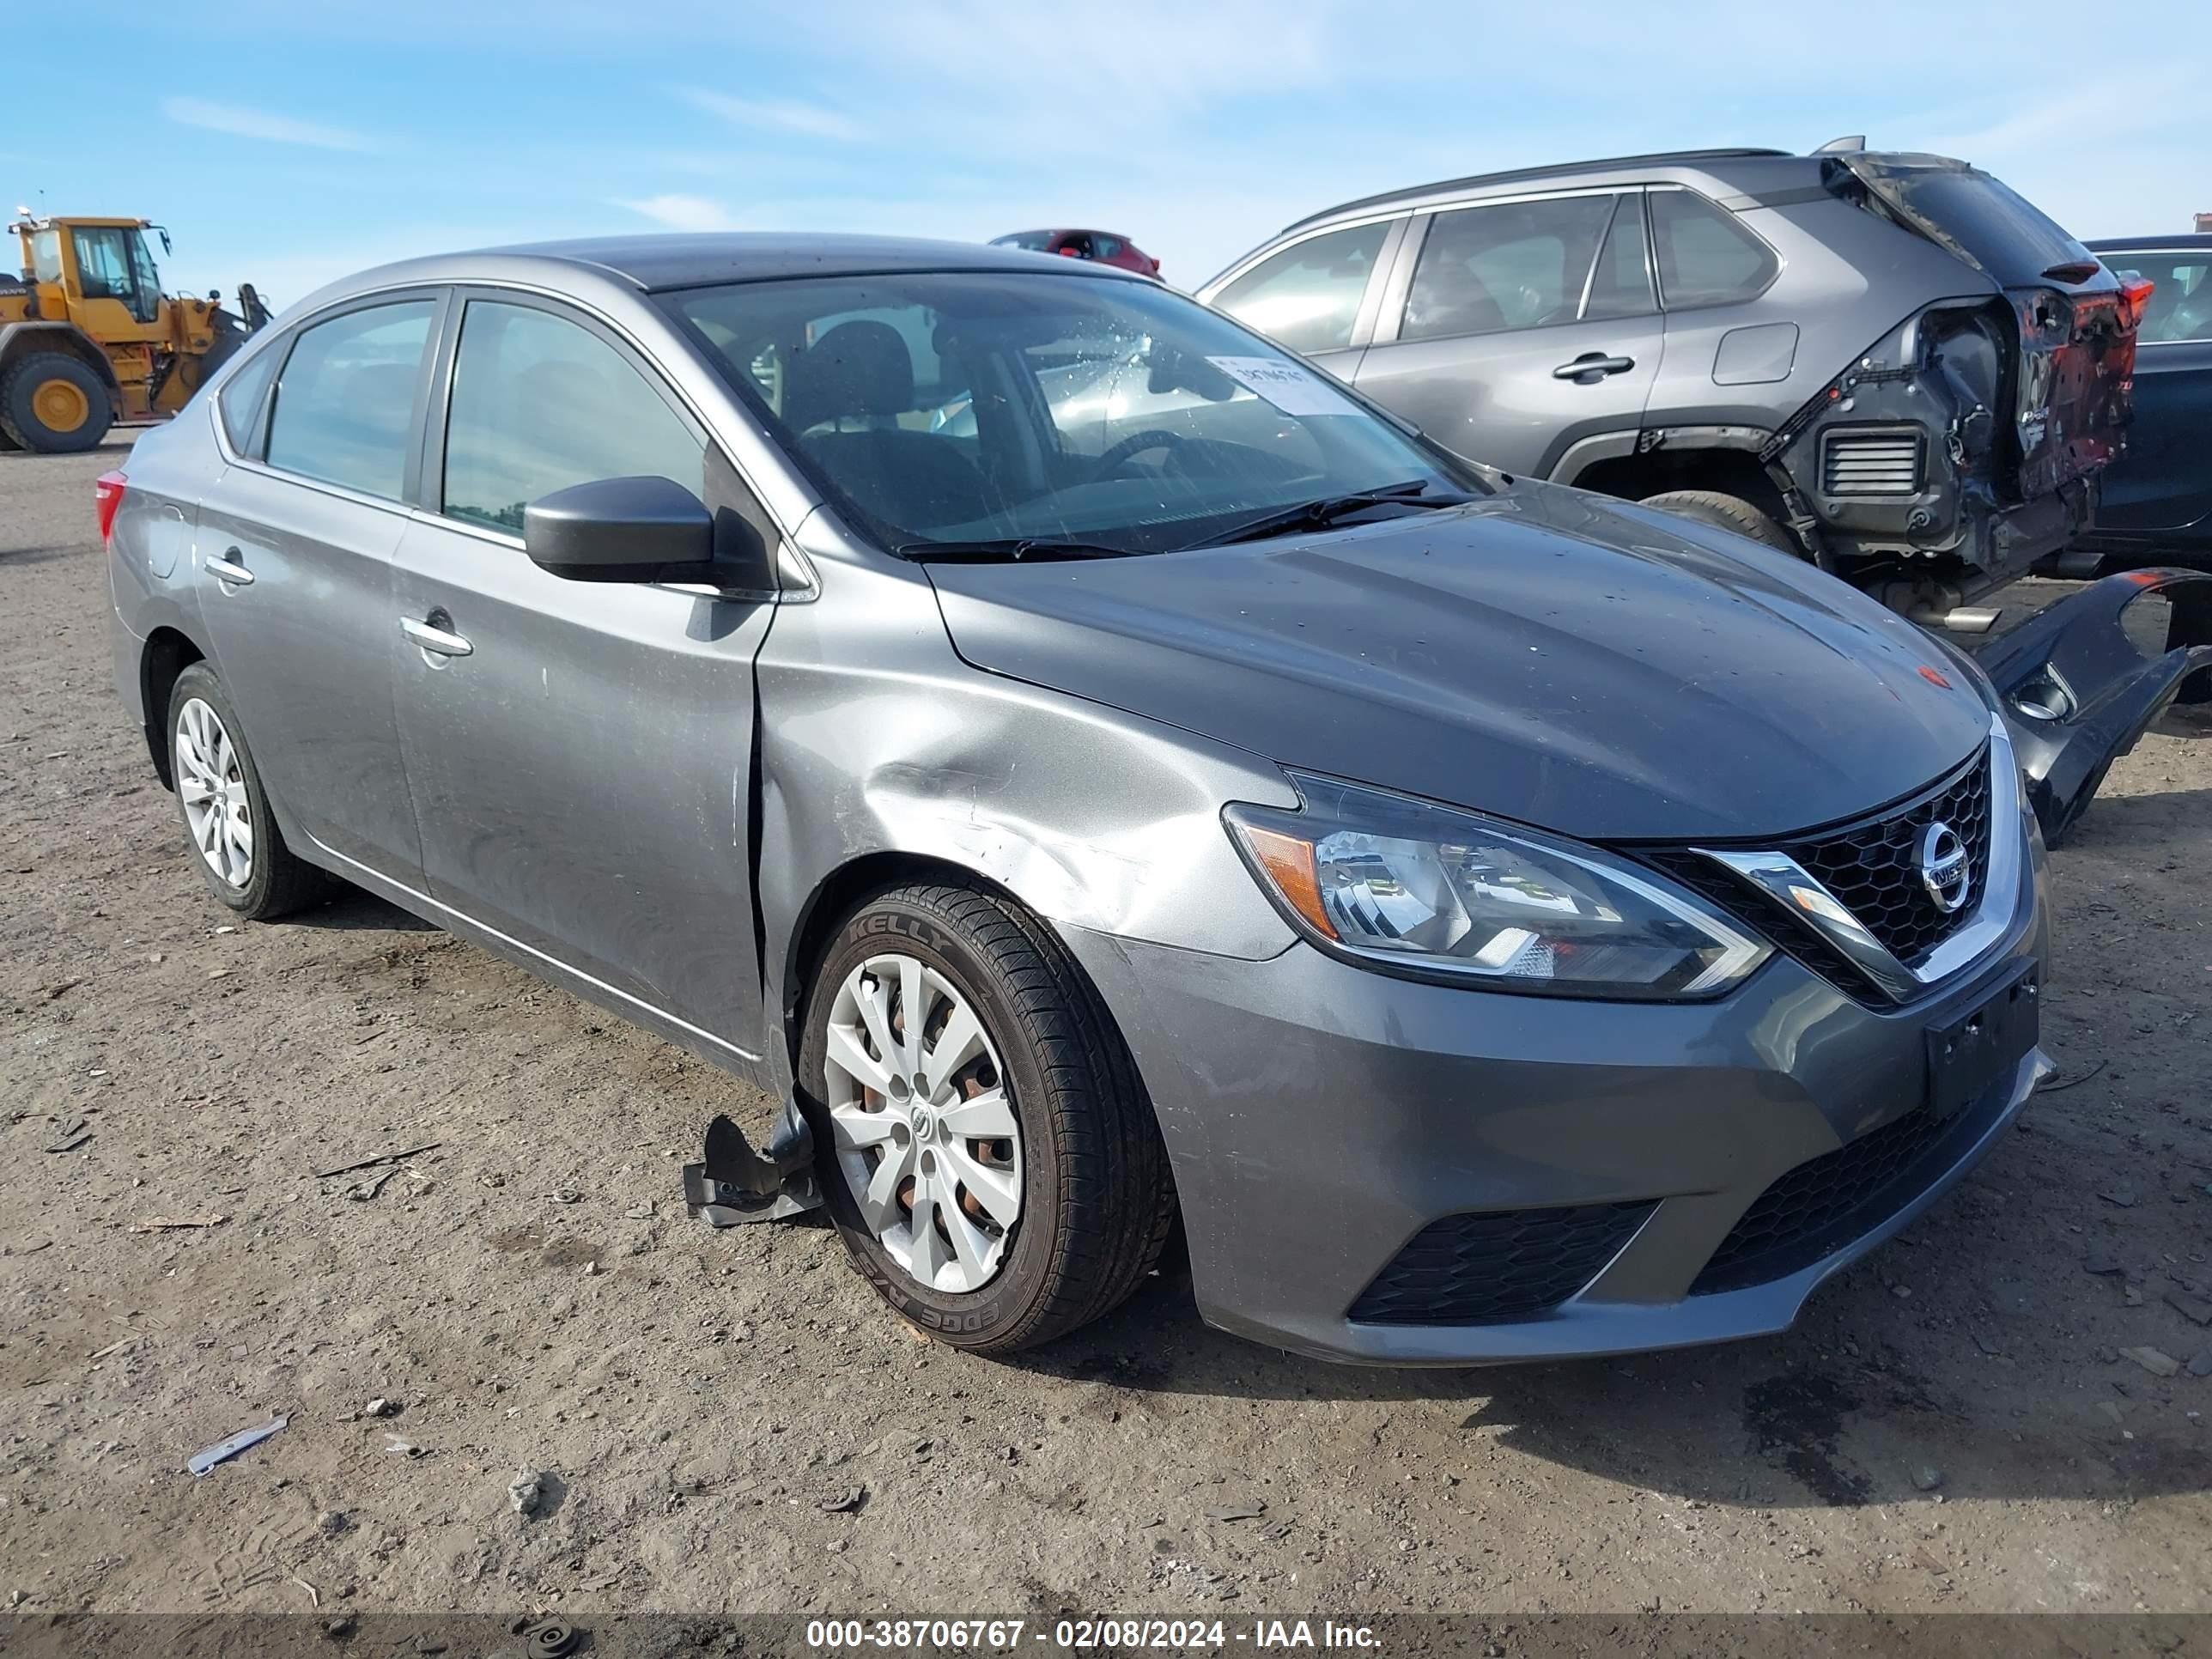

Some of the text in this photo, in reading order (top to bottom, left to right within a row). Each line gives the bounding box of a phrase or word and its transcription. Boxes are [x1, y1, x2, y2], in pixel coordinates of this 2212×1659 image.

[848, 915, 953, 951] KELLY
[855, 1251, 1000, 1332] EDGE A/S
